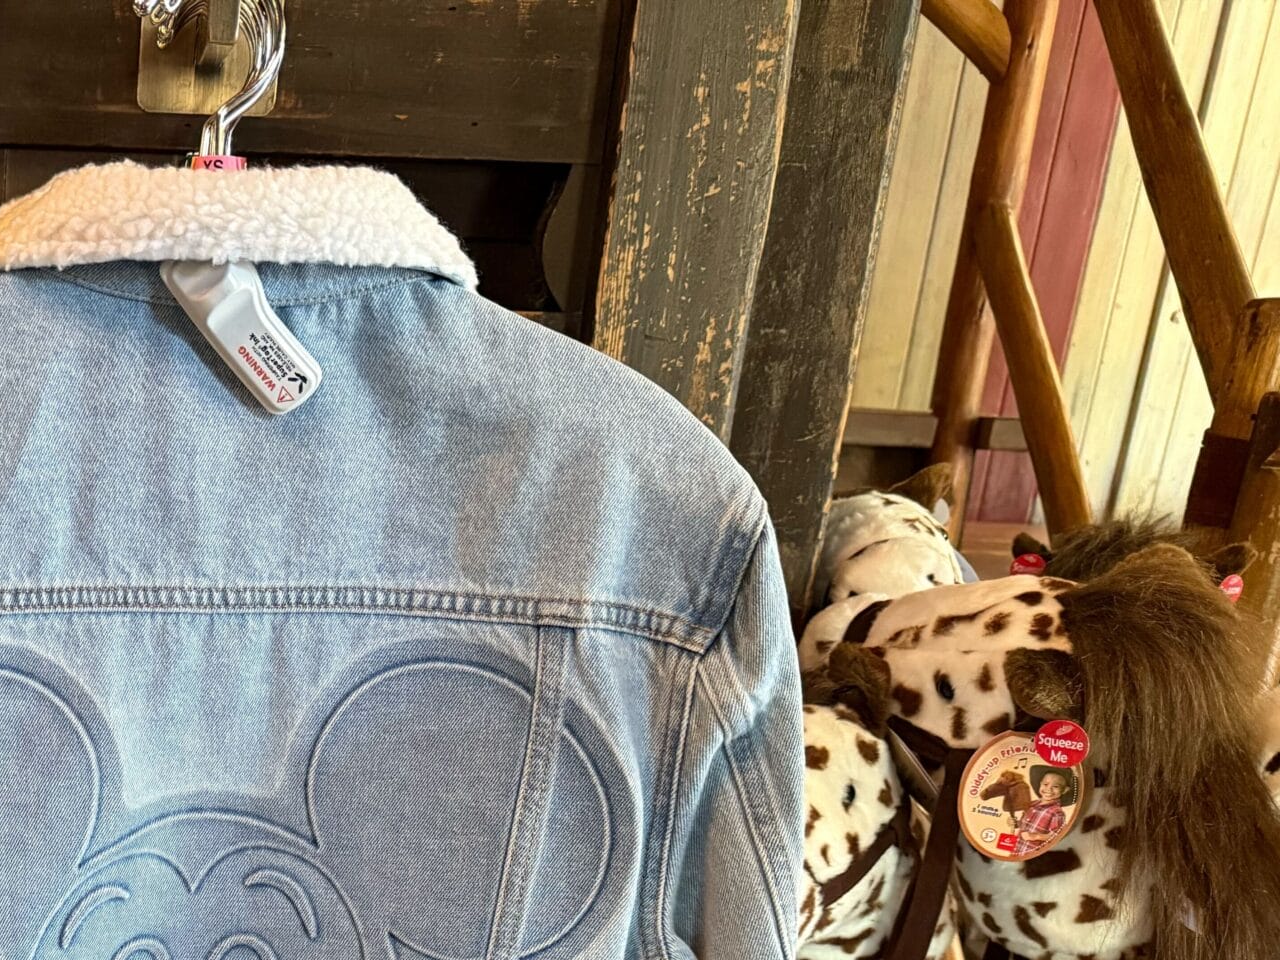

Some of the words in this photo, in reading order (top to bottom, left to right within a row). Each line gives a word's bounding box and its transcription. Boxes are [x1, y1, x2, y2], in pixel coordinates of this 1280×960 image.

[248, 333, 261, 345] Ink
[237, 346, 276, 391] WARNING
[1038, 733, 1084, 751] Squeeze
[1050, 750, 1068, 763] Me
